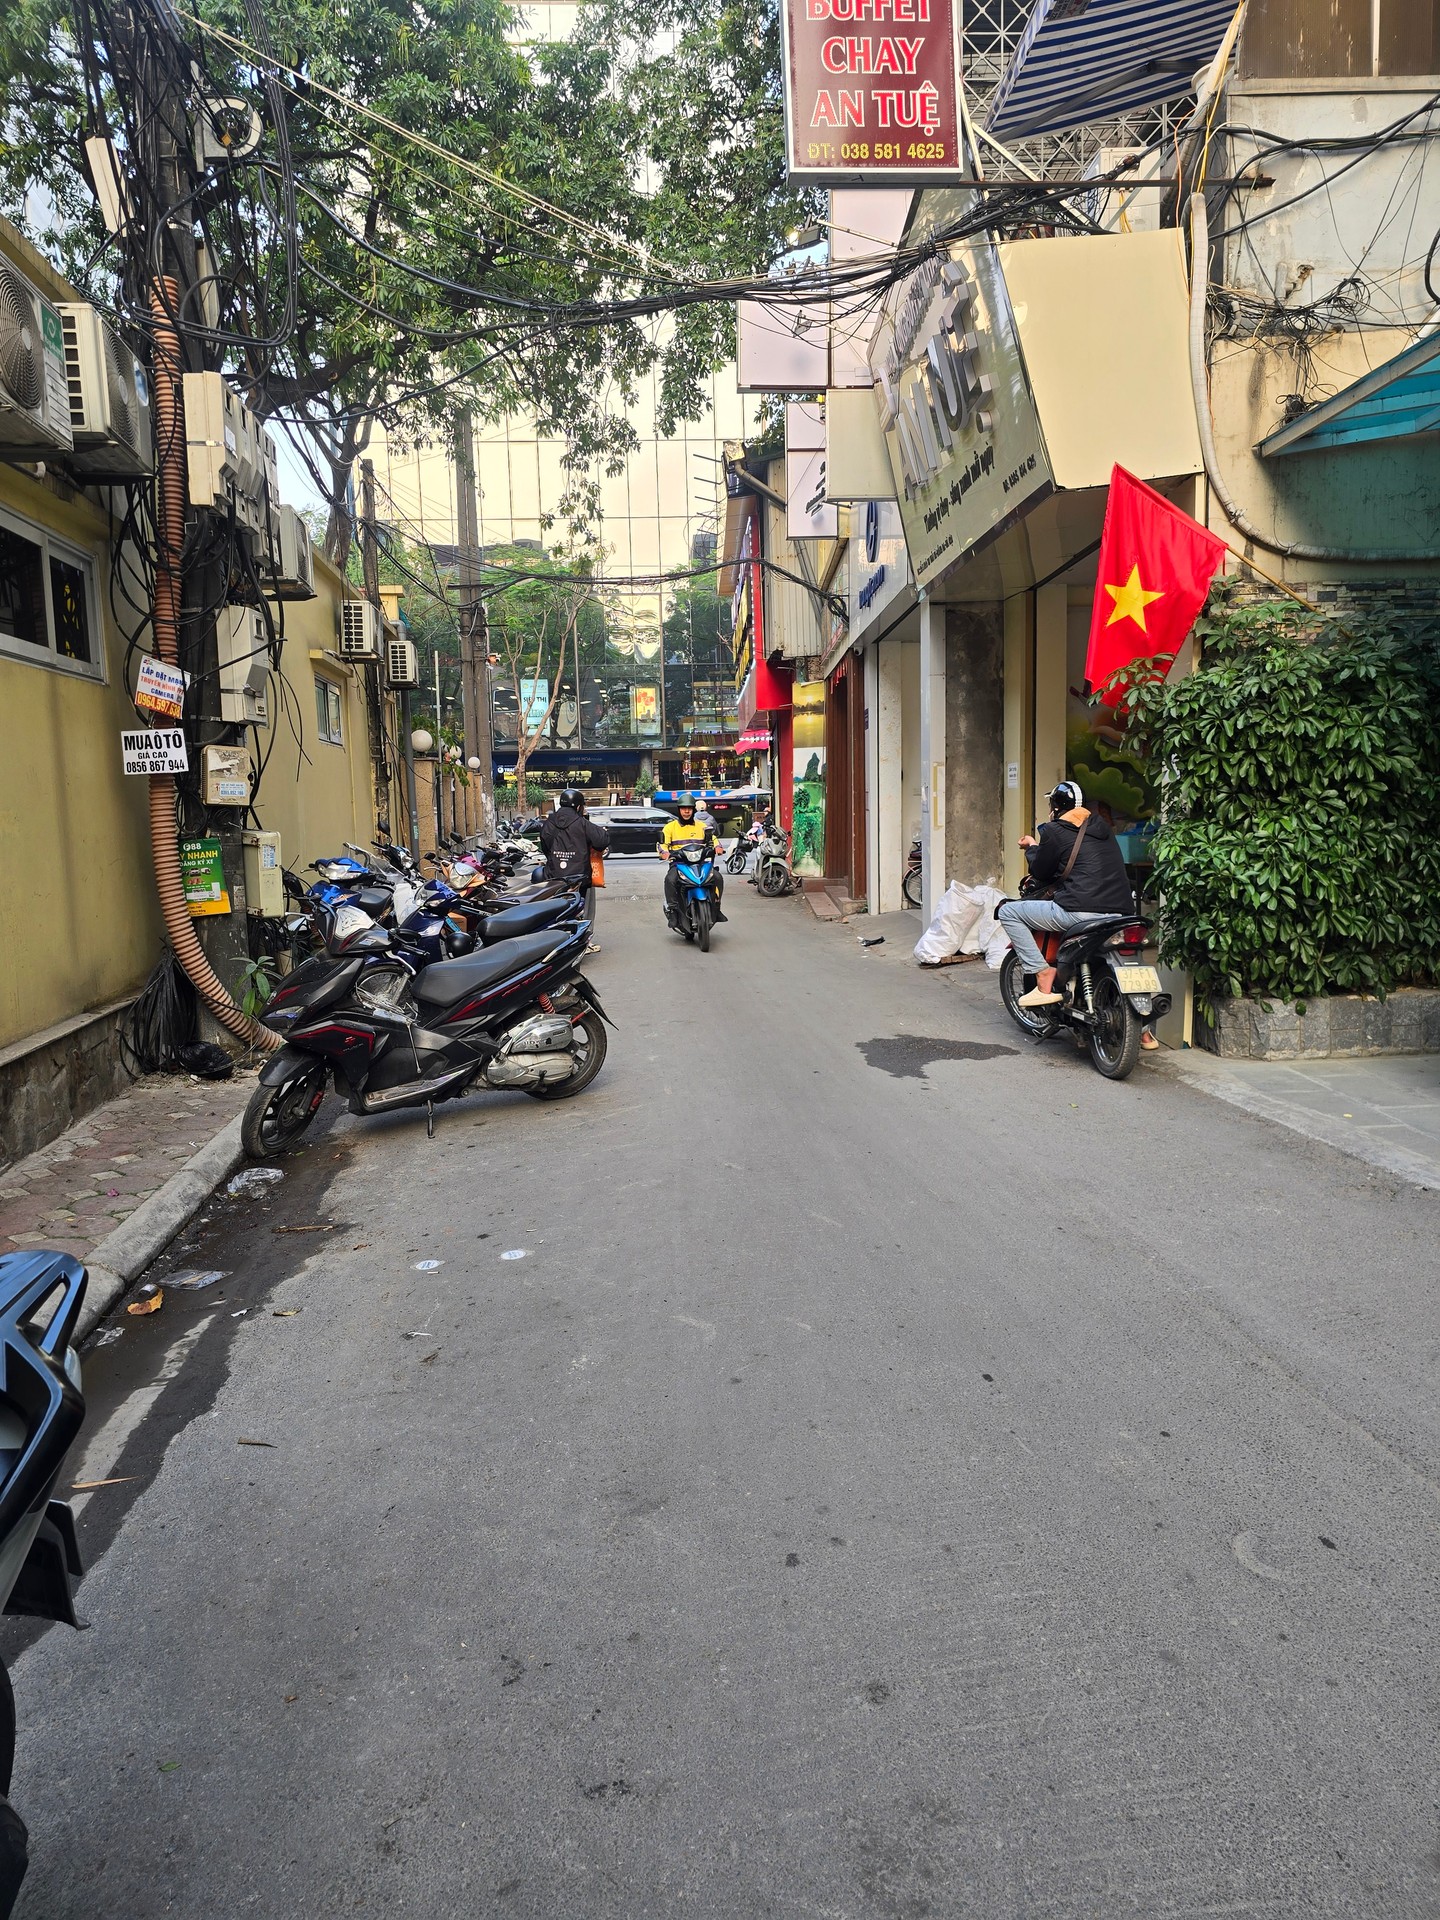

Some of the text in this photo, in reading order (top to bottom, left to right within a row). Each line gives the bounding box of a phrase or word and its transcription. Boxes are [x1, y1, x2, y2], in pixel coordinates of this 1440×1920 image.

[806, 0, 931, 22] BUFFET
[821, 36, 925, 74] CHAY
[810, 80, 940, 136] AN TUỆ
[807, 143, 945, 159] ĐT: 038 581 4625
[150, 688, 174, 700] CAMERA
[137, 751, 168, 760] GIÁ CAO
[126, 759, 185, 773] 0856 867 944
[187, 850, 218, 860] NHANH
